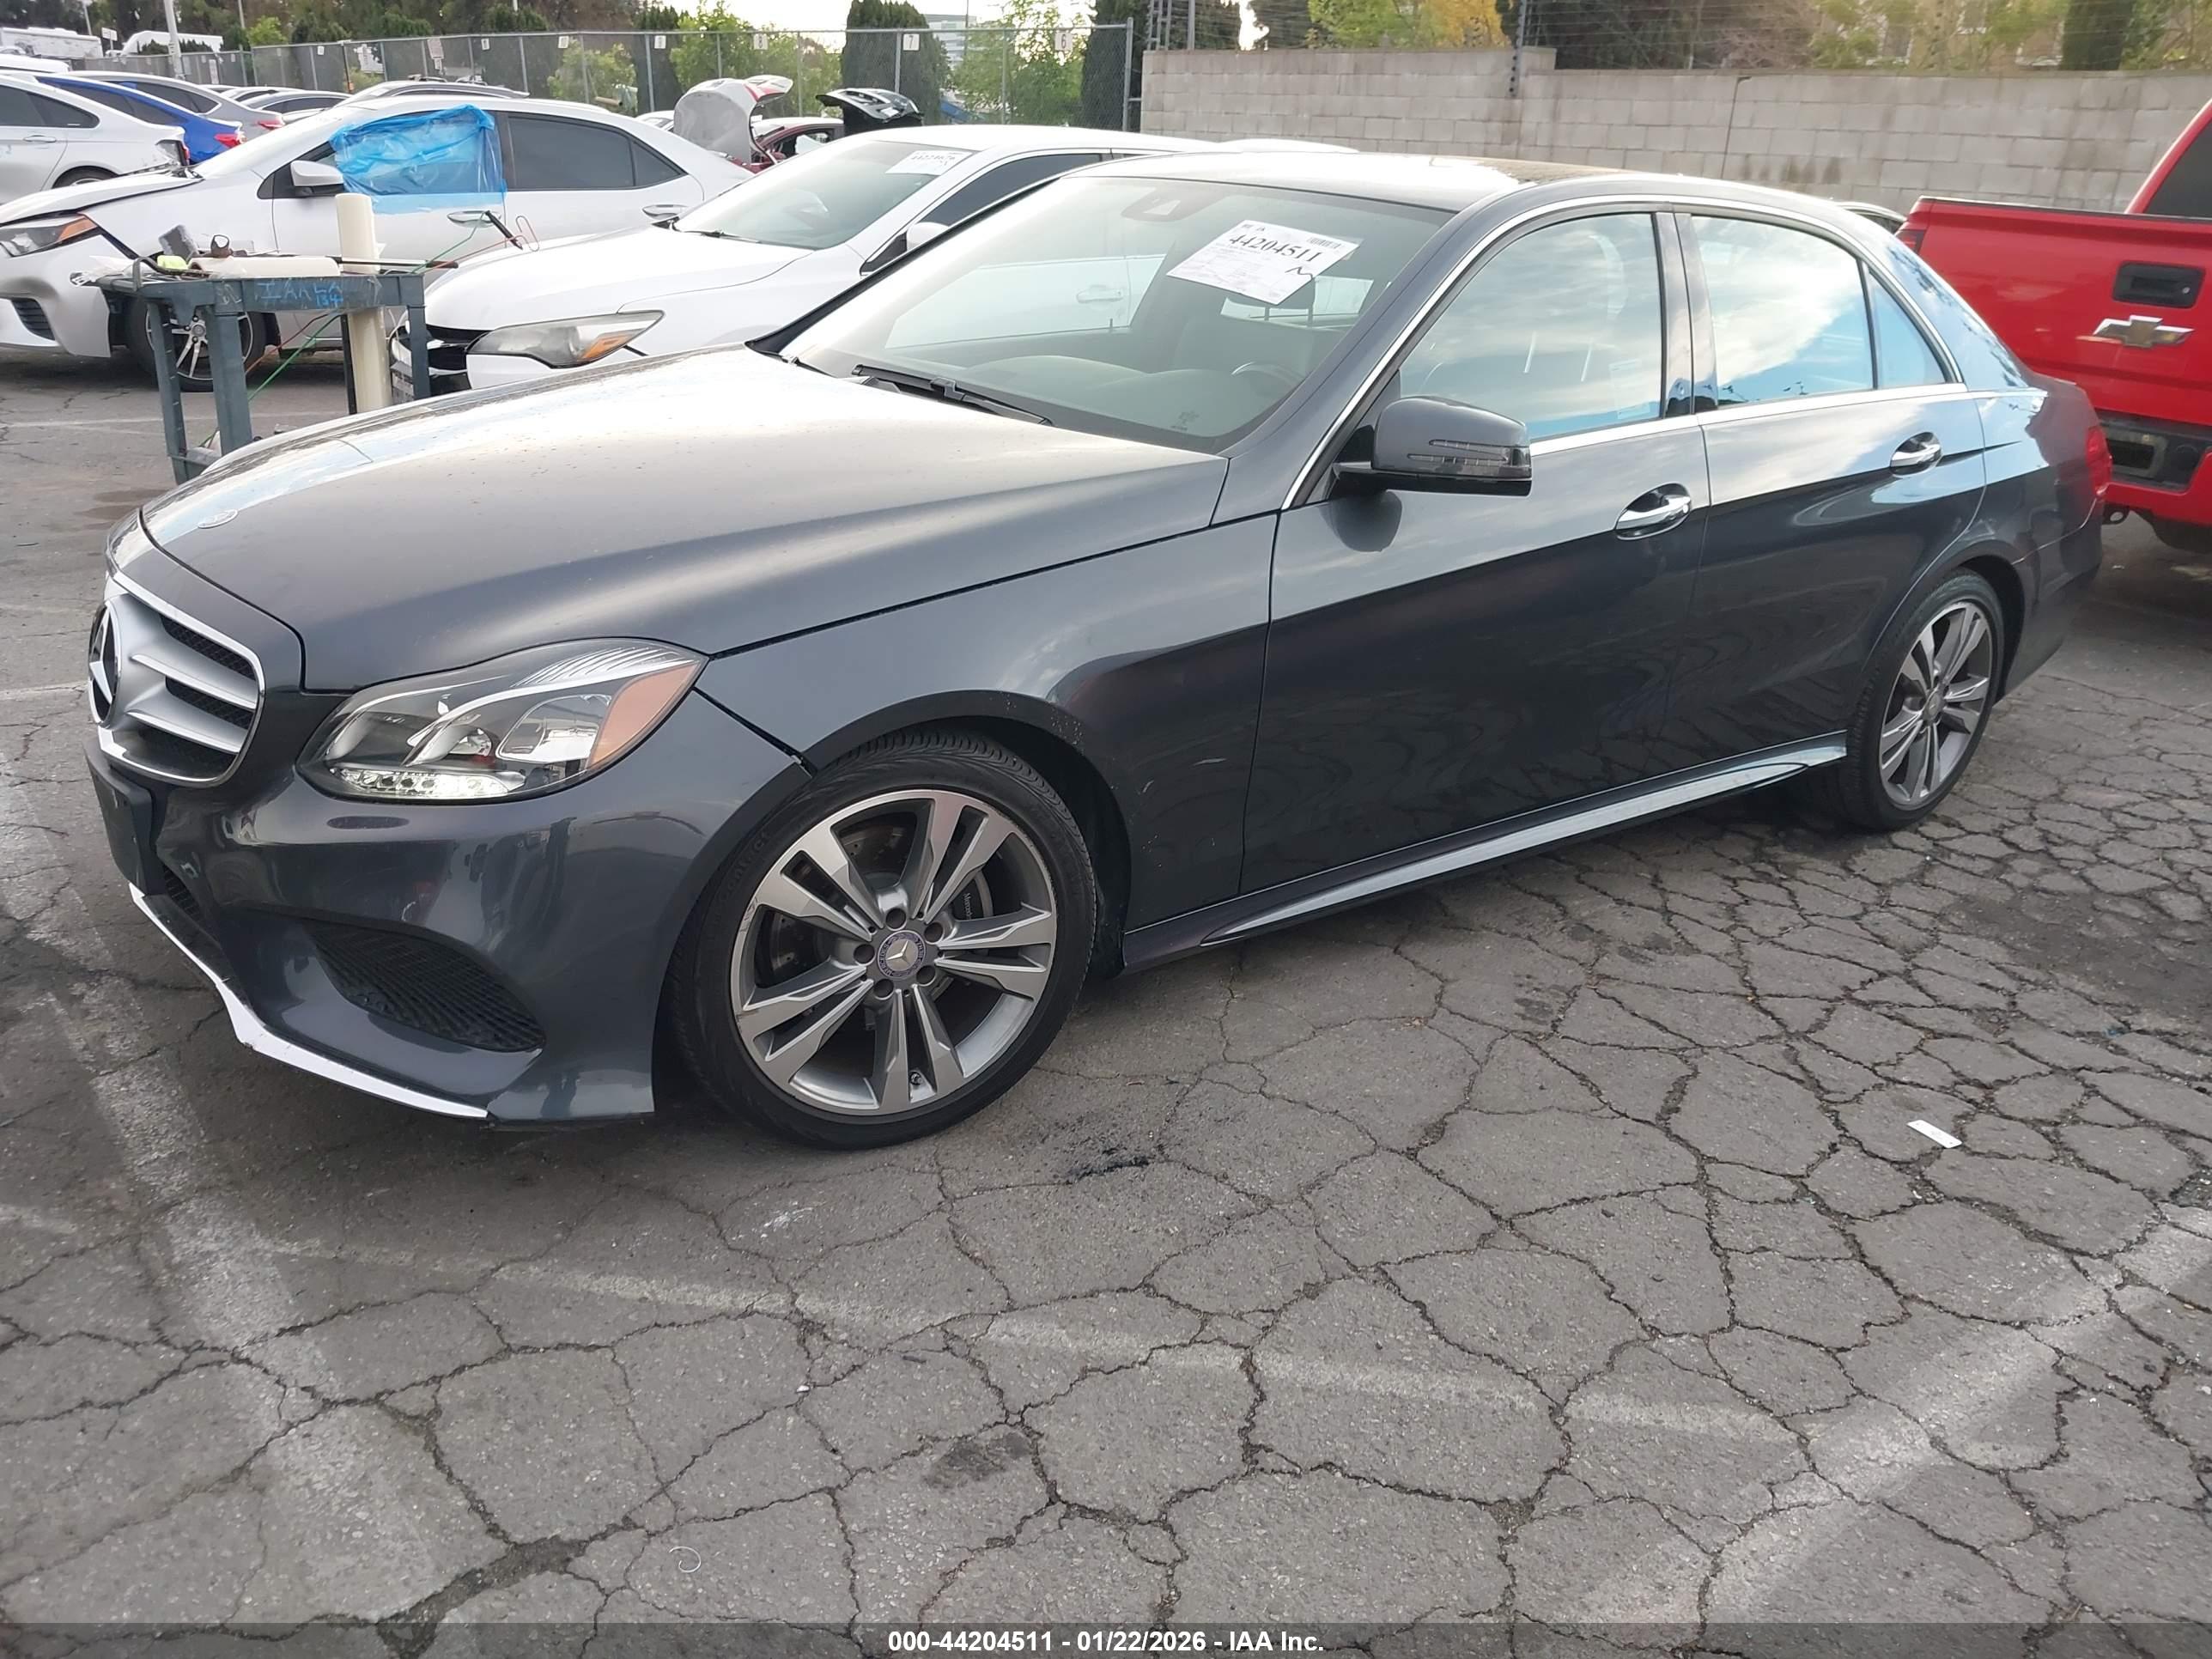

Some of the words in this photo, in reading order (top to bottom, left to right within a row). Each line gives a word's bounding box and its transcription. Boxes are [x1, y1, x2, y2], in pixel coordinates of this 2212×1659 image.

[908, 34, 915, 49] 7
[1060, 33, 1066, 49] 6
[1229, 234, 1322, 261] 44204511
